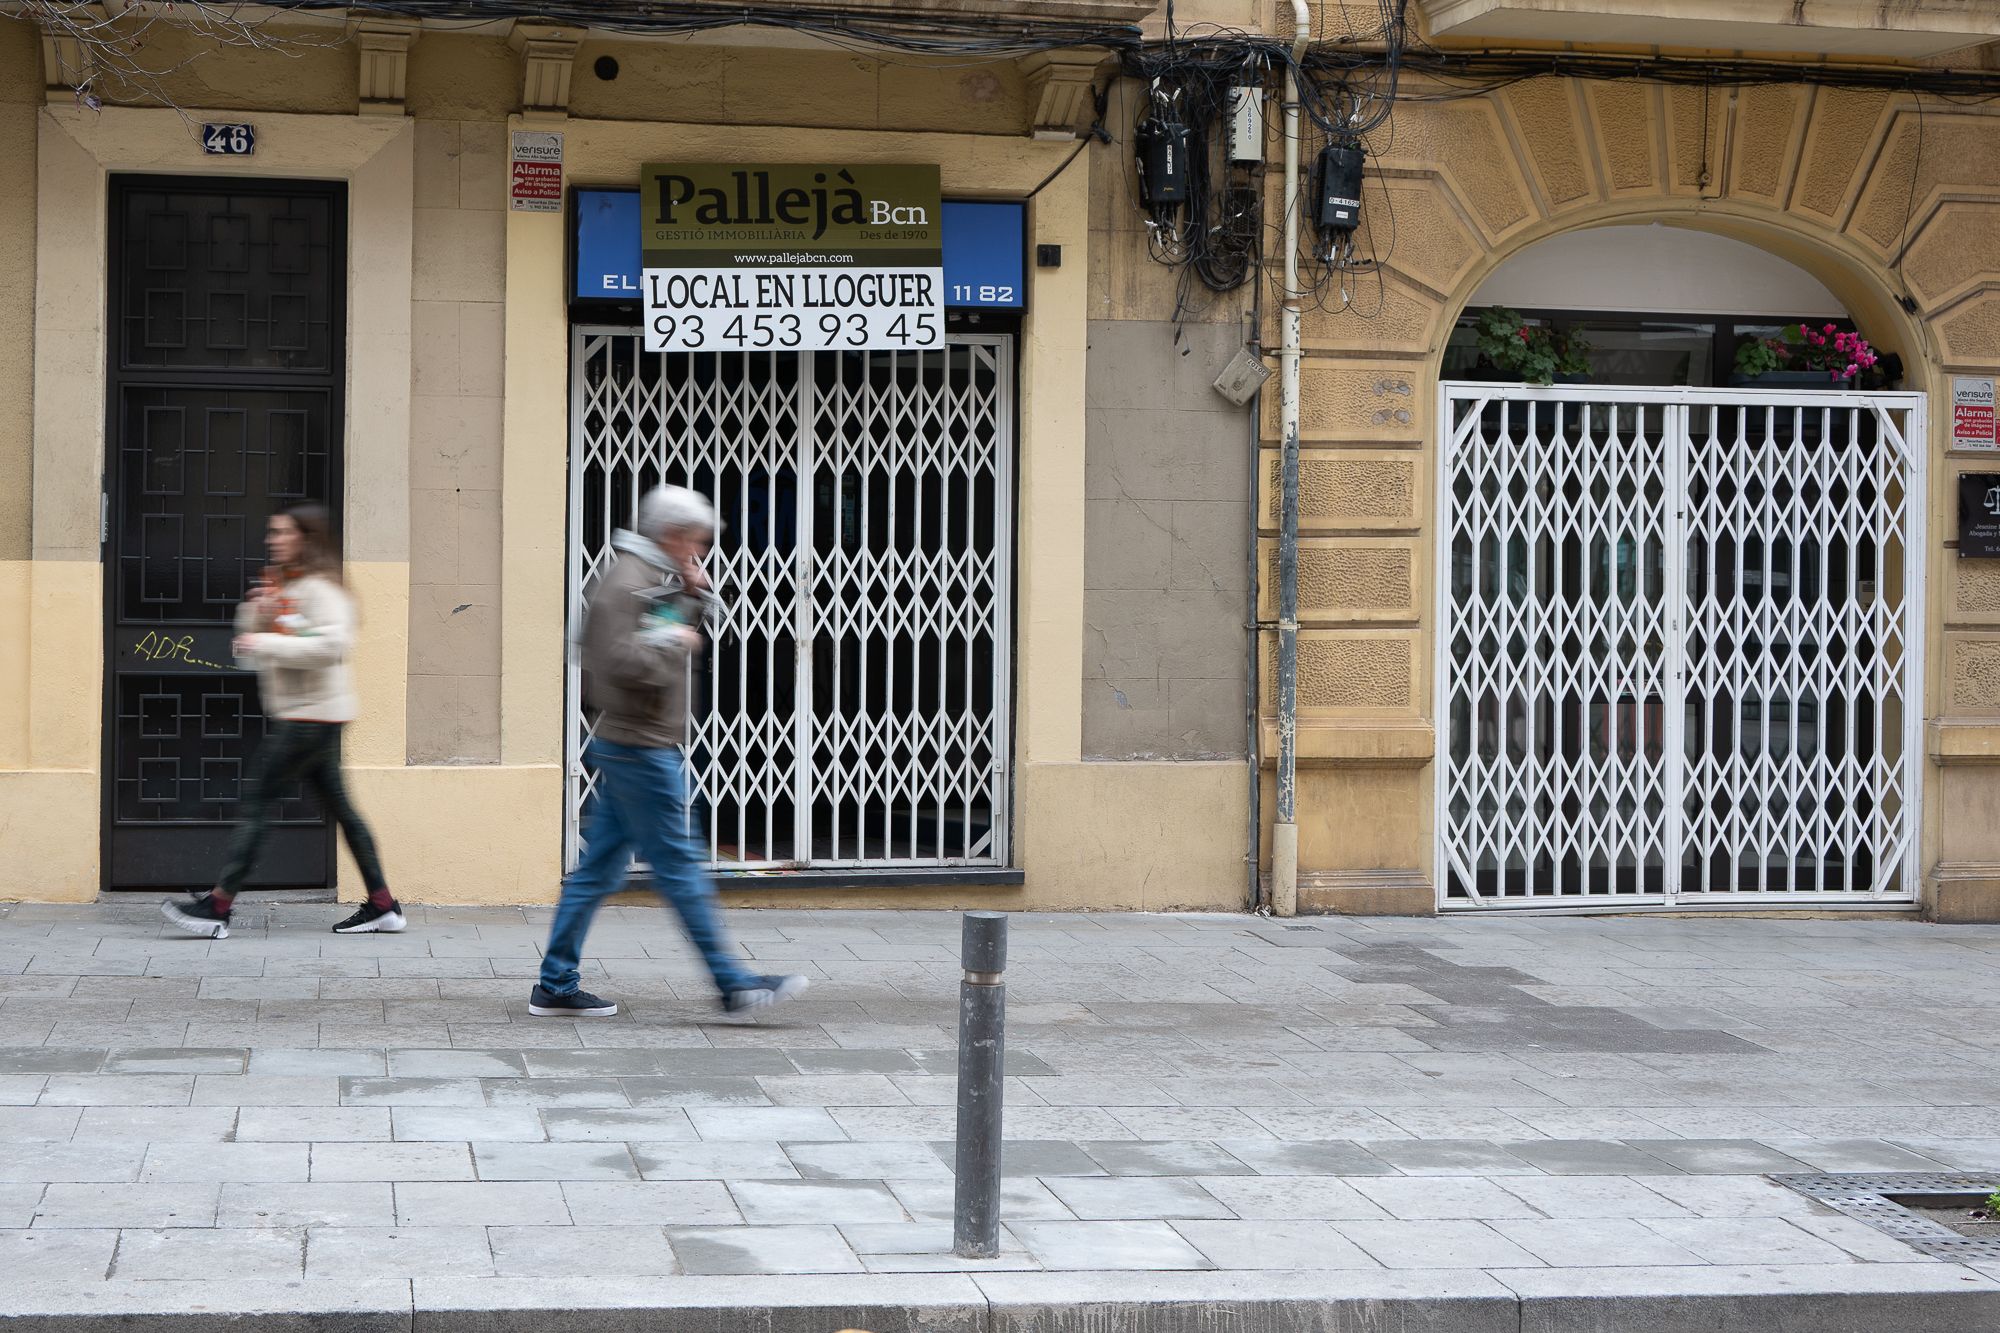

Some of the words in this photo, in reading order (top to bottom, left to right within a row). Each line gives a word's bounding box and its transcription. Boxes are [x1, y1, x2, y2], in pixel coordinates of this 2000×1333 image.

[206, 125, 248, 153] 46
[515, 146, 561, 155] verisure
[514, 164, 560, 176] Alarma
[654, 168, 867, 240] Pallejà
[870, 200, 928, 225] Bcn
[656, 228, 704, 240] GESTIÓ
[708, 228, 806, 240] IMMOBILIÀRIA
[860, 230, 881, 240] Des
[884, 230, 898, 240] de
[902, 230, 928, 240] 1970
[734, 253, 854, 264] www.pallejabcn.com
[650, 274, 749, 309] LOCAL
[755, 274, 795, 308] EN
[802, 274, 935, 307] LLOGUER
[653, 314, 705, 348] 93
[722, 313, 802, 347] 453
[819, 313, 869, 346] 93
[885, 313, 936, 346] 45
[1956, 391, 1993, 399] verisure
[1956, 408, 1993, 418] Alarma
